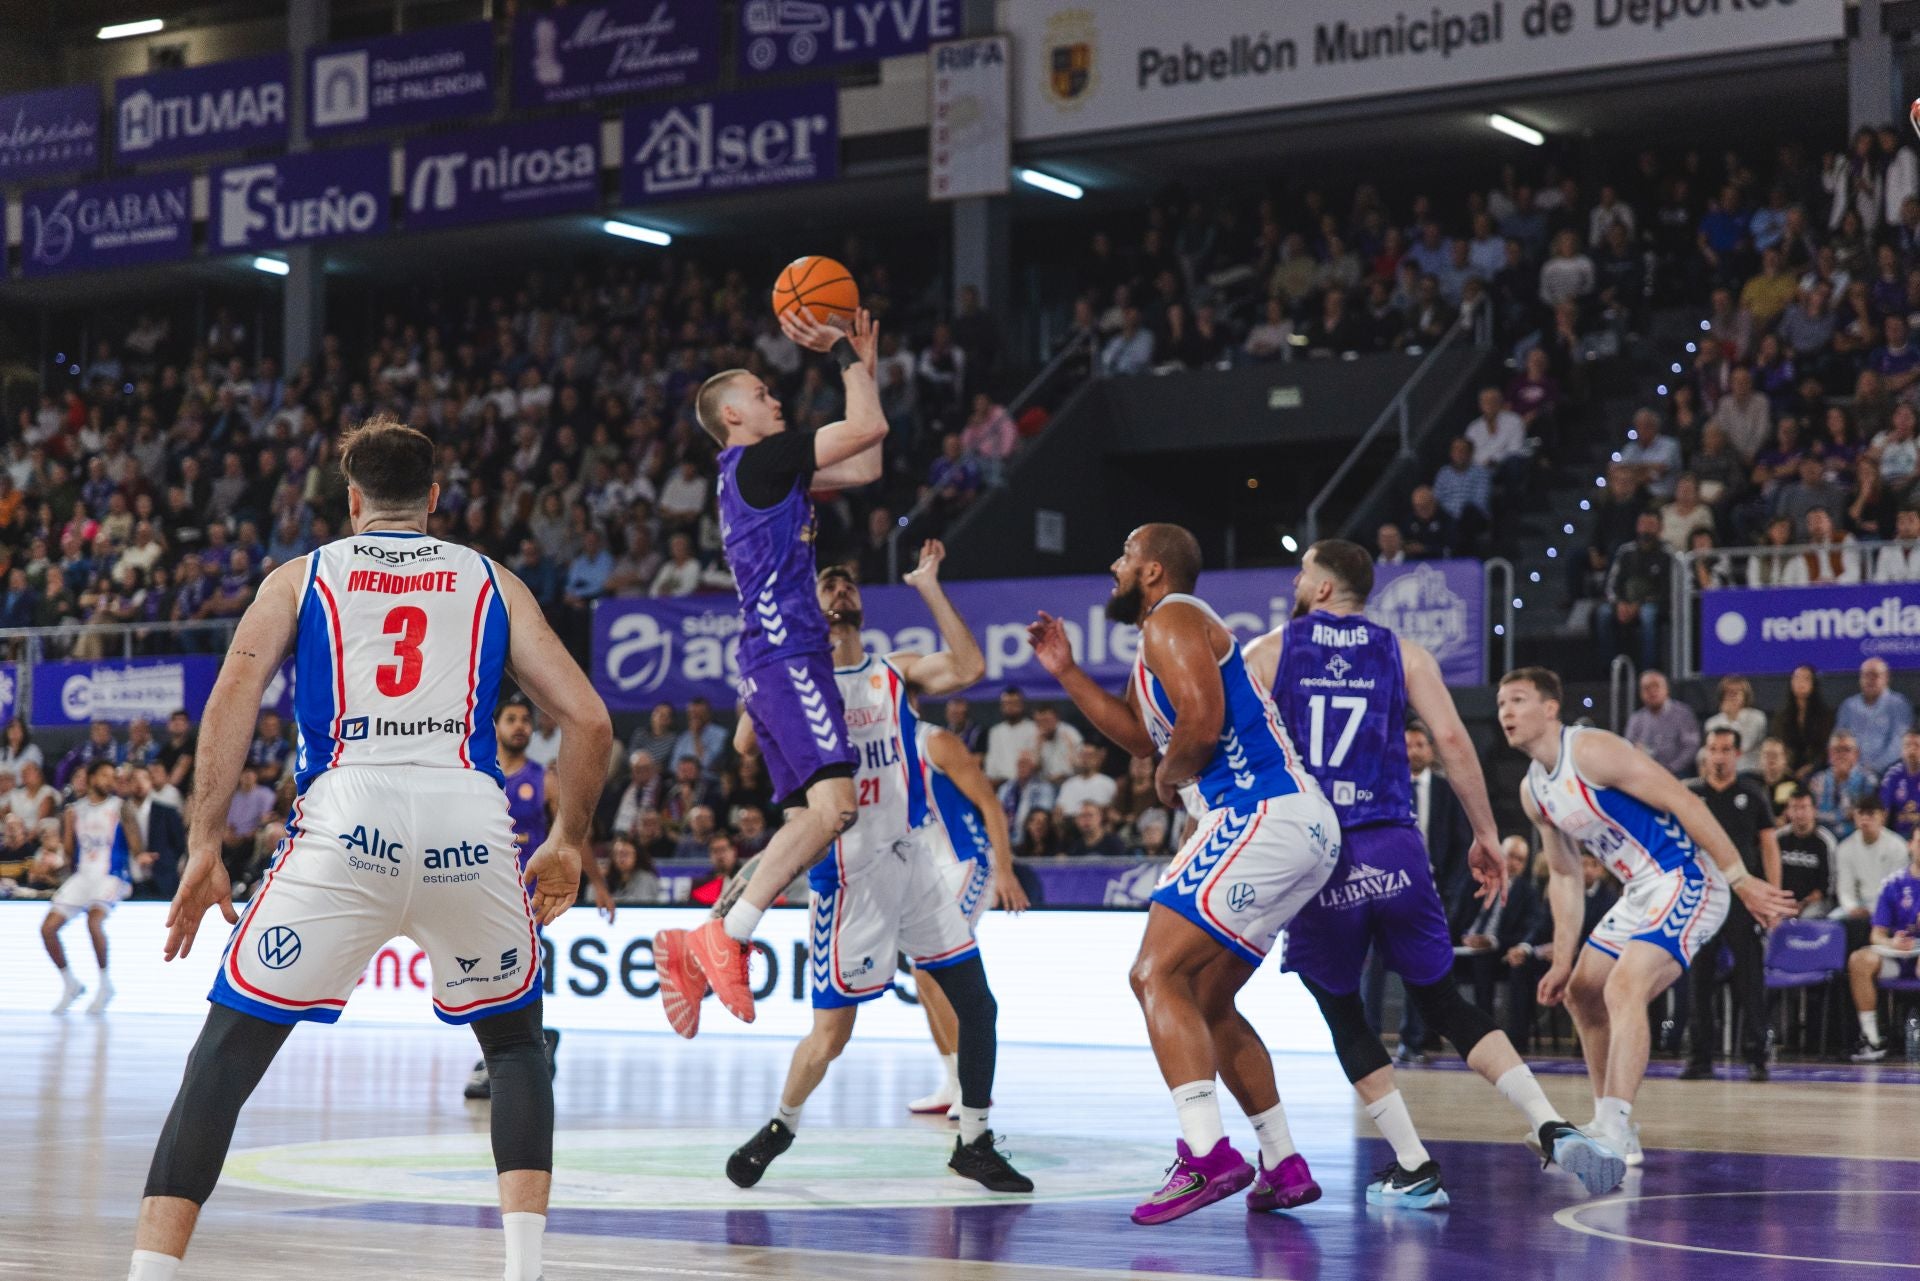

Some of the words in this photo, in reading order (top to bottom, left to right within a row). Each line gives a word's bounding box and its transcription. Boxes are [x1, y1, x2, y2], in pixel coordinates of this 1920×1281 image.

[833, 0, 956, 51] LYVE
[1138, 32, 1297, 89] Pabellón
[1314, 3, 1503, 65] Municipal
[1523, 0, 1576, 38] de
[471, 144, 596, 191] nirosa
[347, 570, 458, 595] MENDIKOTE
[375, 605, 428, 697] 3
[1311, 623, 1369, 648] ARMUŠ
[1348, 677, 1376, 689] salud
[375, 717, 468, 737] Inurban
[1308, 694, 1368, 768] 17
[865, 736, 901, 769] HLA
[858, 776, 880, 806] 21
[348, 855, 387, 876] Sports
[422, 871, 481, 884] estination
[1318, 868, 1412, 908] LEBANZA
[446, 976, 490, 988] CUPRA
[493, 966, 522, 982] SEAT
